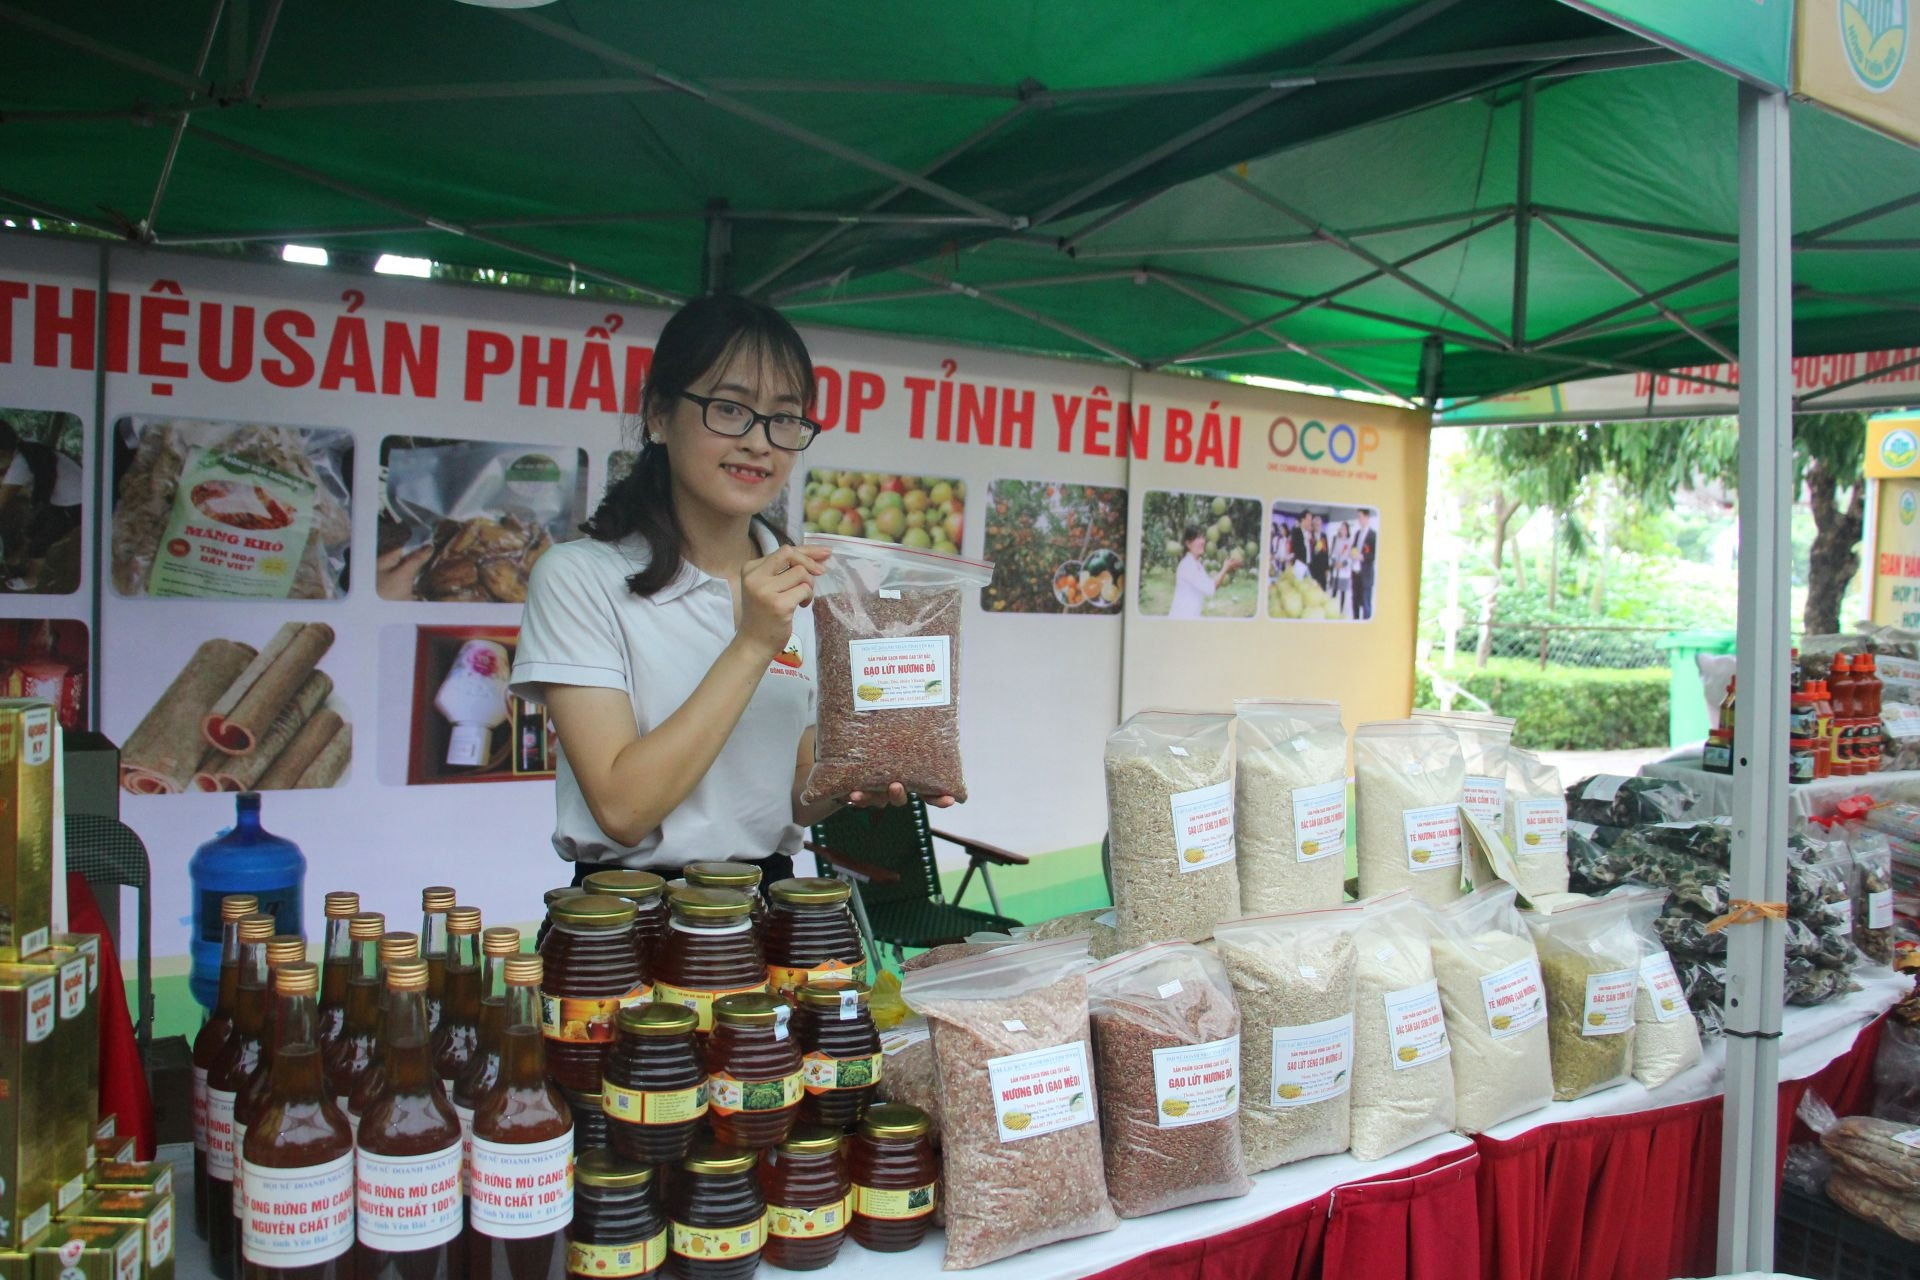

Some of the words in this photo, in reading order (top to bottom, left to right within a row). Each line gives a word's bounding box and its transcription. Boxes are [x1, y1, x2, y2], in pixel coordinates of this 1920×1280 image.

[904, 358, 1036, 450] TỈNH
[1052, 385, 1150, 460] YÊN
[1164, 401, 1241, 469] BÁI
[1268, 416, 1379, 466] OCOP
[864, 666, 880, 678] GẠO
[882, 662, 895, 675] LỨT
[926, 660, 936, 673] ĐỎ
[1002, 1085, 1032, 1101] NƯƠNG
[1034, 1079, 1043, 1095] ĐỎ
[1168, 1077, 1186, 1090] GẠO
[1188, 1073, 1202, 1087] LỨT
[375, 1184, 405, 1199] RỪNG
[409, 1182, 427, 1198] MÙ
[431, 1175, 456, 1195] CANG
[484, 1172, 512, 1189] RỪNG
[516, 1174, 534, 1189] MÙ
[538, 1169, 563, 1186] CANG
[273, 1200, 307, 1215] RỪNG
[311, 1195, 329, 1213] MÙ
[397, 1200, 427, 1218] CHẤT
[505, 1191, 534, 1207] CHẤT
[252, 1219, 295, 1235] NGUYÊN
[299, 1214, 329, 1234] CHẤT
